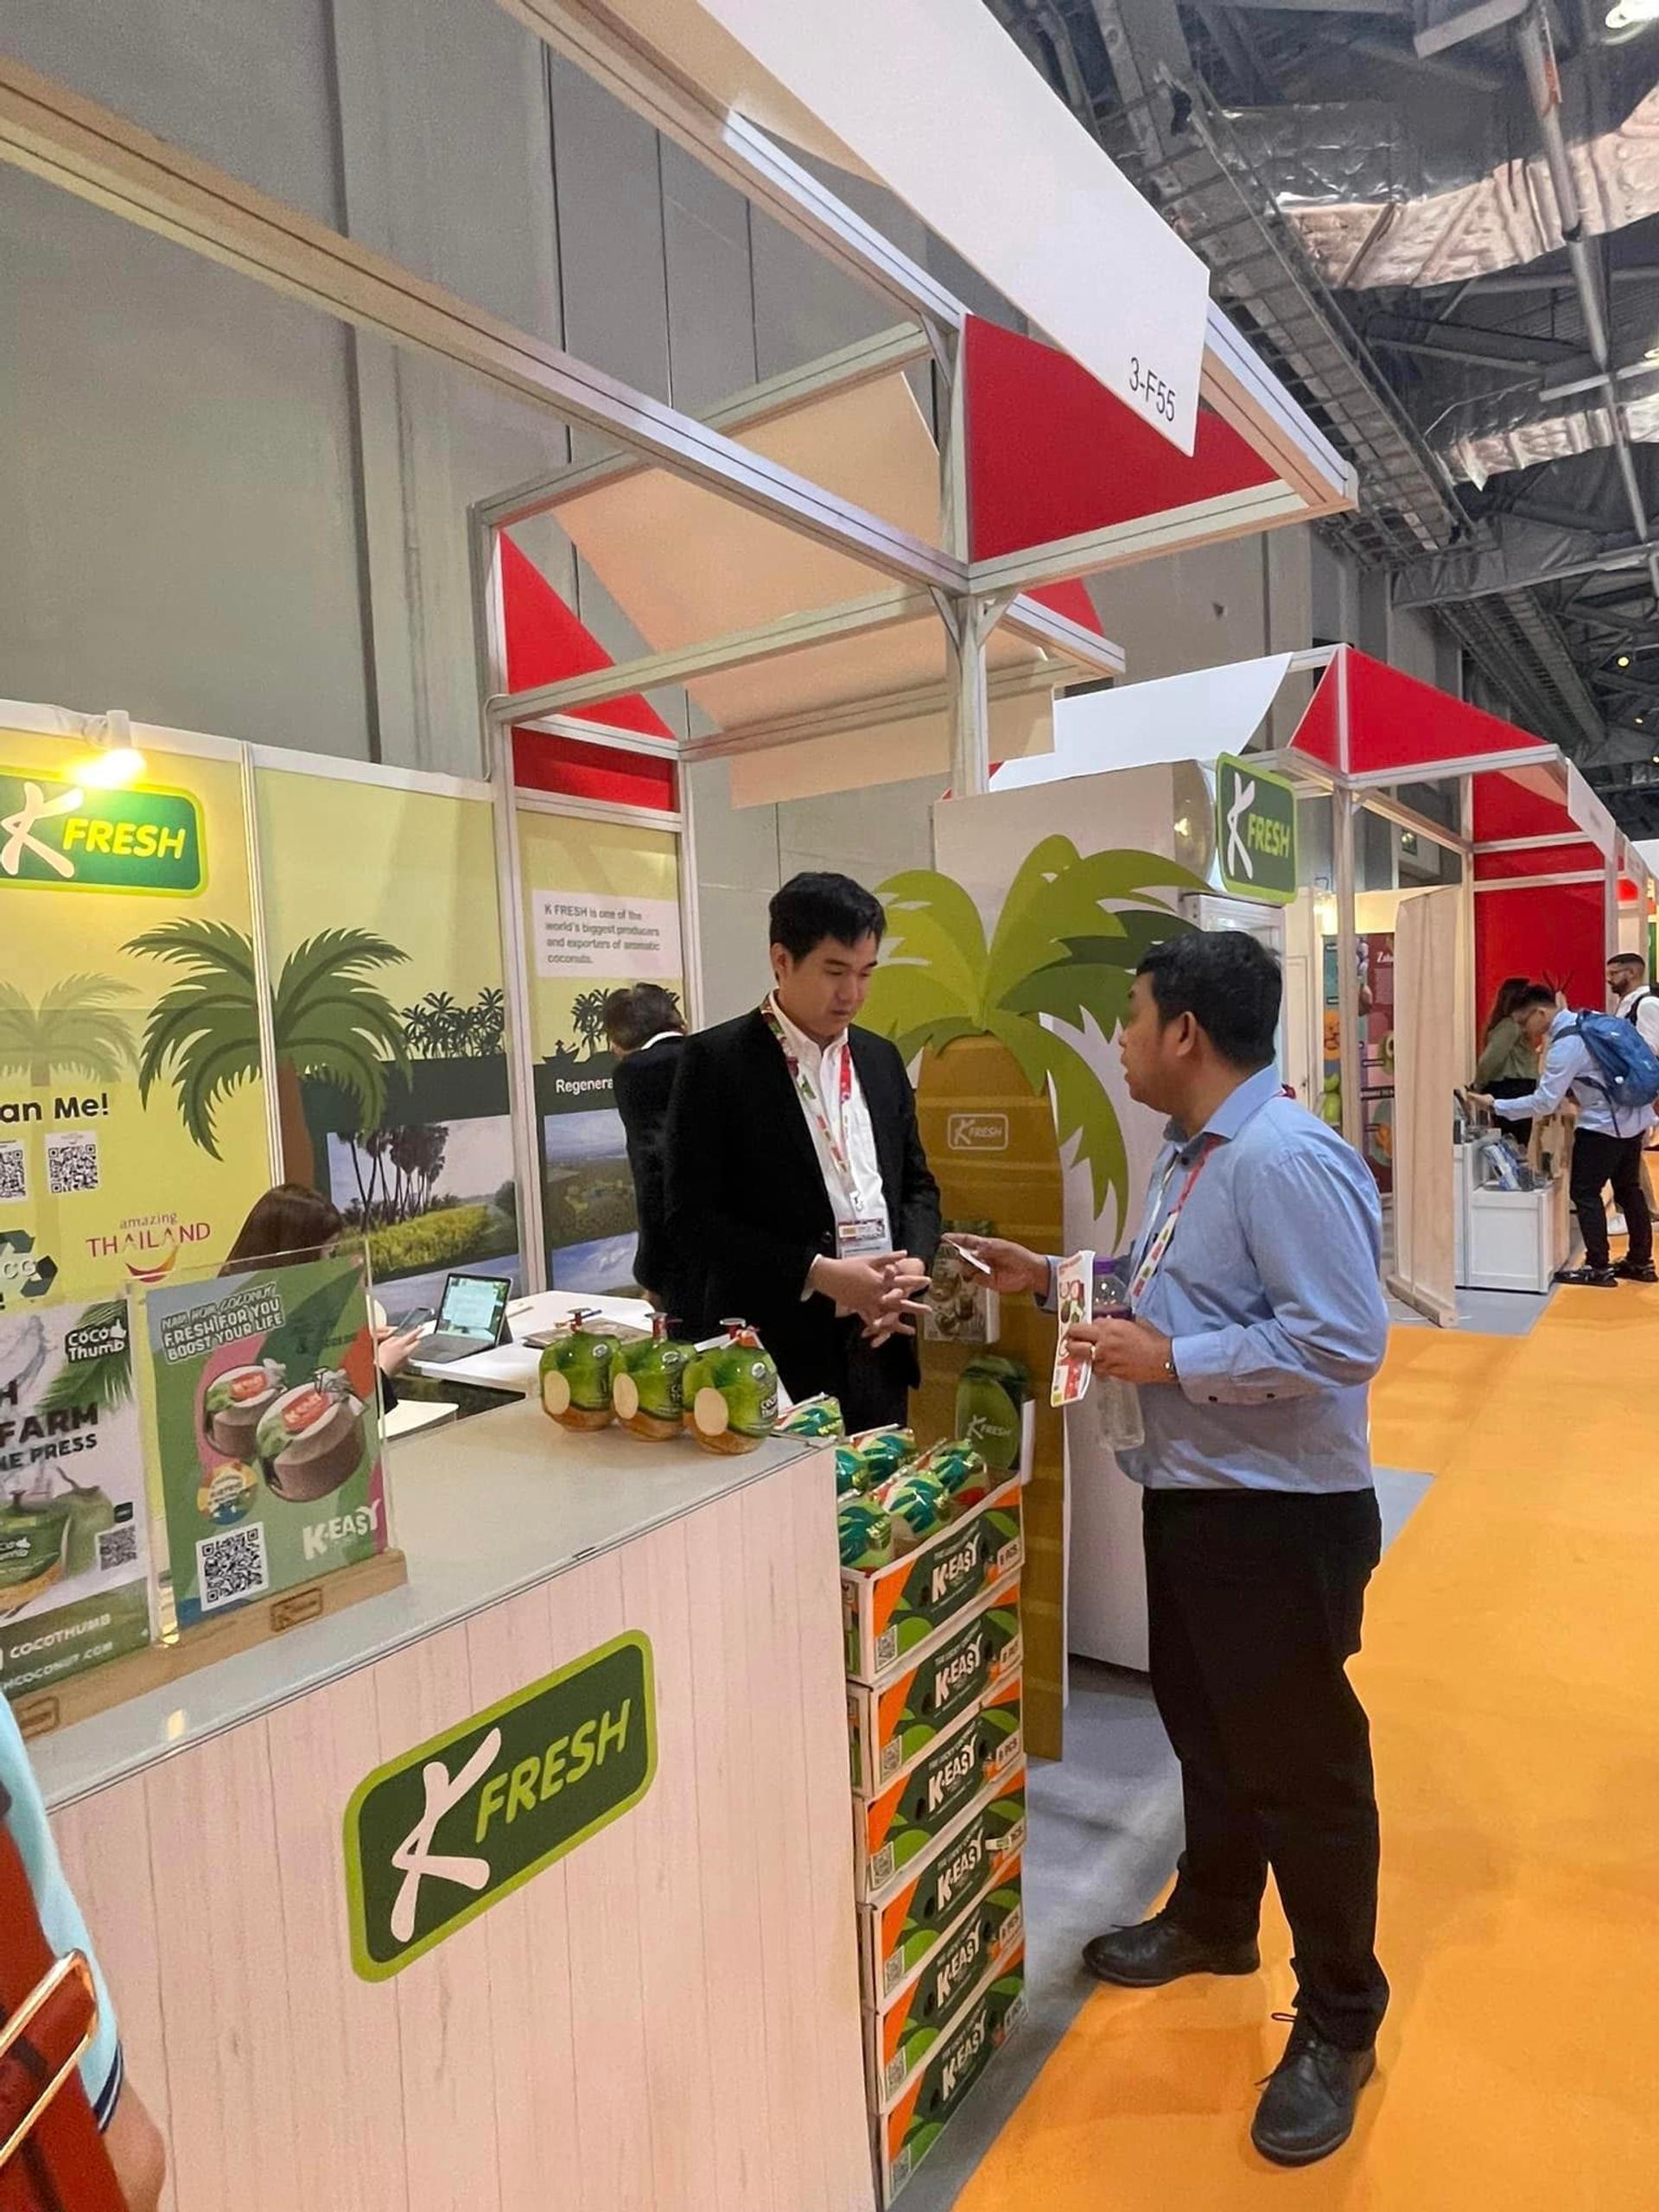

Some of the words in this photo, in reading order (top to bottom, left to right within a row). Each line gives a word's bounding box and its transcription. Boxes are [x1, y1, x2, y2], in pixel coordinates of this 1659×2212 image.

[1128, 357, 1176, 422] 3-F55
[0, 781, 84, 879] K
[62, 817, 186, 860] FRESH
[1227, 772, 1255, 880] K
[1247, 812, 1291, 858] FRESH
[544, 904, 552, 915] K
[554, 905, 588, 917] FRESH
[546, 938, 565, 948] and
[0, 1102, 42, 1122] an
[54, 1092, 109, 1119] Me!
[556, 1078, 613, 1096] Regenera
[86, 1223, 212, 1257] THAILAND
[119, 1212, 178, 1229] amazing
[164, 1319, 215, 1348] FRESH
[218, 1308, 248, 1329] FOR
[251, 1298, 281, 1318] YOU
[168, 1337, 212, 1361] BOOST
[216, 1323, 252, 1344] YOUR
[255, 1313, 283, 1332] LIFE
[0, 1402, 99, 1448] FARM
[30, 1433, 98, 1463] PRESS
[10, 1613, 111, 1658] COCOTHUMB
[391, 1727, 502, 1942] K
[475, 1699, 632, 1843] FRESH
